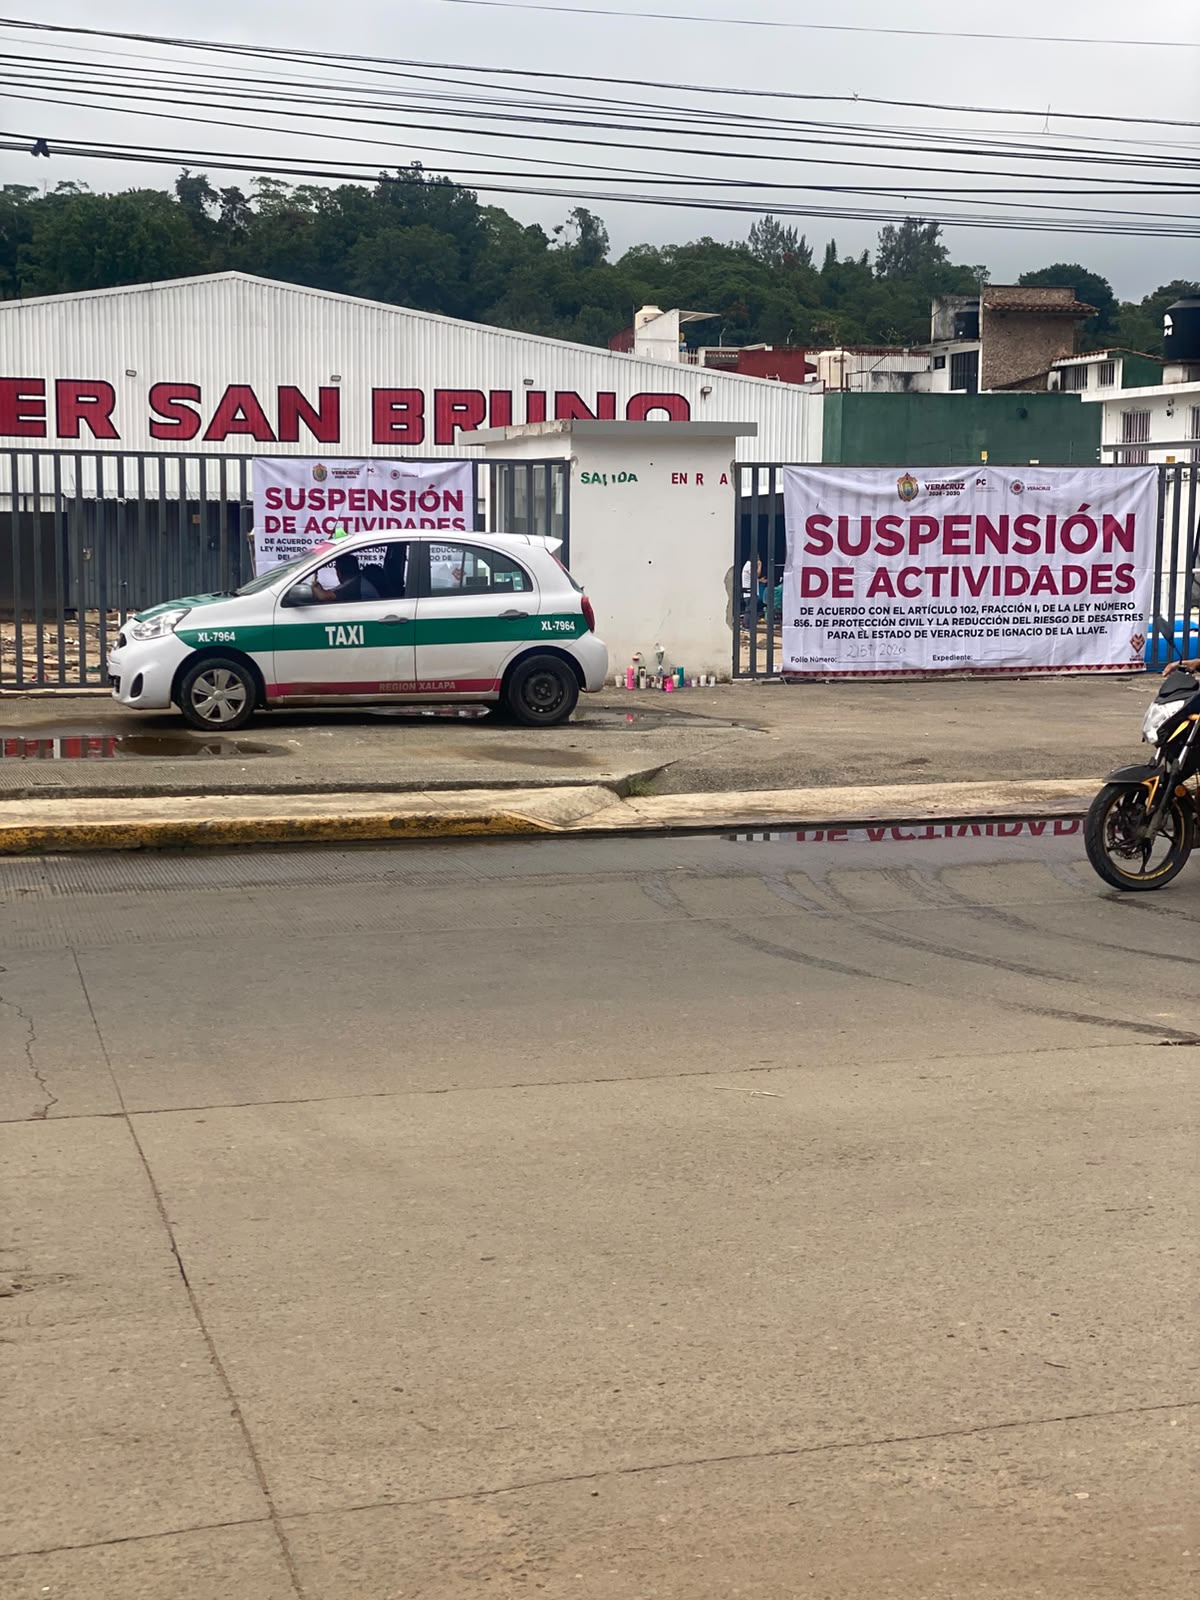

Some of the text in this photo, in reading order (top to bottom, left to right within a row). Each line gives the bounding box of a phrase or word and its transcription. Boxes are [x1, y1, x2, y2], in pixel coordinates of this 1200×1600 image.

[149, 381, 341, 444] SAN
[265, 484, 463, 512] SUSPENSIÓN
[265, 516, 296, 534] DE
[803, 503, 1136, 556] SUSPENSIÓN
[800, 563, 1136, 599] DE ACTIVIDADES
[800, 607, 814, 615] DE
[817, 607, 866, 615] ACUERDO
[868, 606, 891, 615] CON
[893, 606, 905, 614] EL
[907, 604, 957, 615] ARTÍCULO
[960, 605, 979, 615] 102,
[981, 603, 1032, 614] FRACCIÓN
[1043, 604, 1055, 612] DE
[1058, 604, 1071, 612] LA
[1073, 603, 1091, 612] LEY
[1094, 601, 1136, 611] NÚMERO
[540, 620, 575, 631] XL-7964
[815, 619, 829, 627] DE
[832, 616, 896, 627] PROTECCIÓN
[899, 618, 924, 626] CIVIL
[927, 618, 934, 626] Y
[936, 618, 949, 626] LA
[952, 616, 1010, 626] REDUCCIÓN
[1012, 616, 1031, 625] DEL
[1033, 615, 1069, 624] RIESGO
[1072, 615, 1085, 623] DE
[1088, 613, 1144, 623] DESASTRES
[197, 631, 236, 643] XL-7964
[324, 624, 365, 646] TAXI
[827, 626, 1108, 640] PARA EL ESTADO DE VERACRUZ DE IGNACIO DE LA LLAVE.
[378, 681, 456, 691] REGION XALAPA
